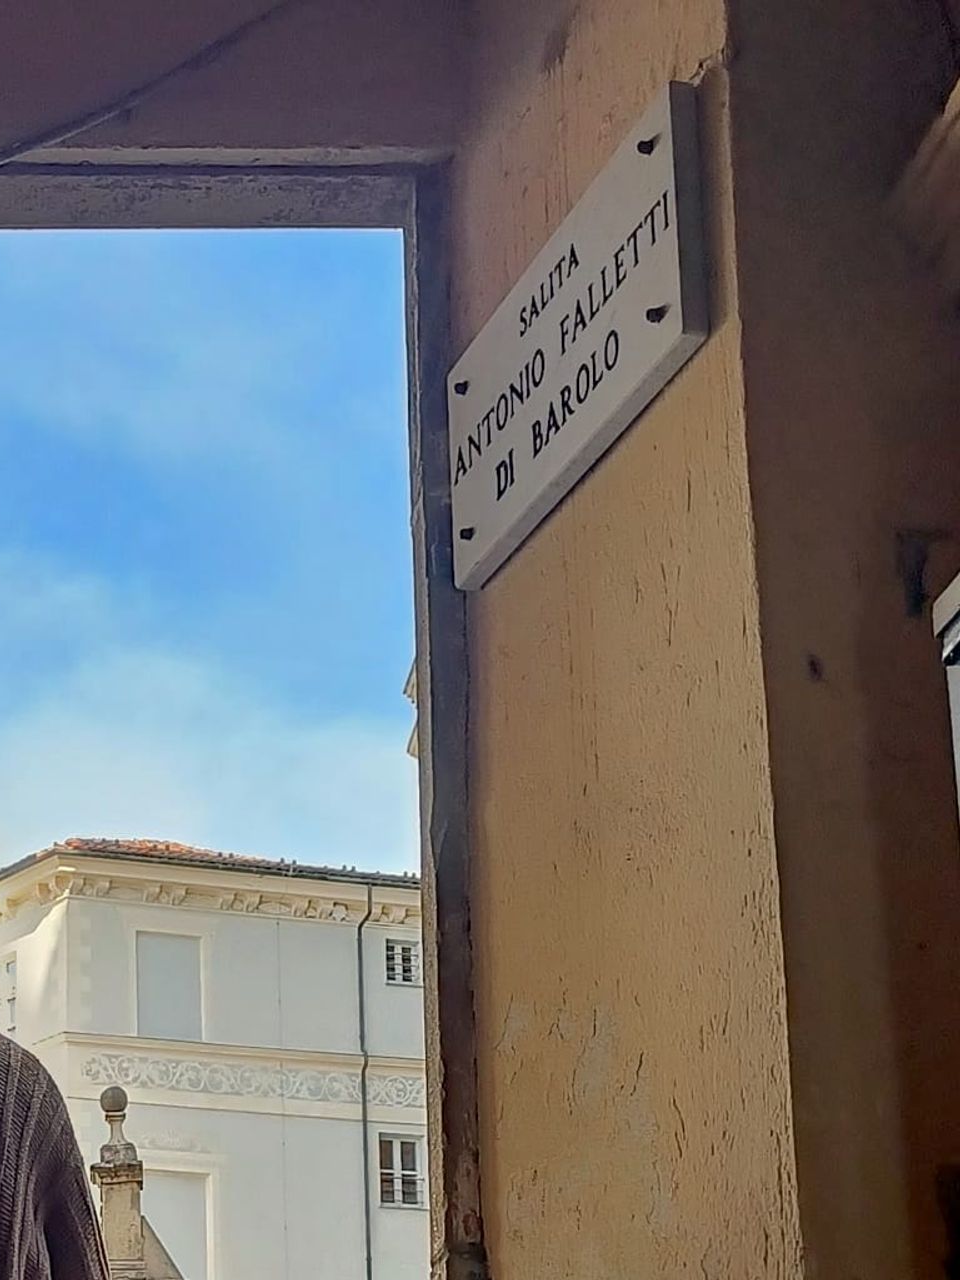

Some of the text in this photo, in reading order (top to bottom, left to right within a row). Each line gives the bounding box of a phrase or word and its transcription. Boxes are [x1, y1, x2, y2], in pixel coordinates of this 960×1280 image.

[453, 190, 670, 487] ANTONIO FALLETTI
[519, 242, 580, 338] SALITA
[496, 330, 619, 502] DI BAROLO
